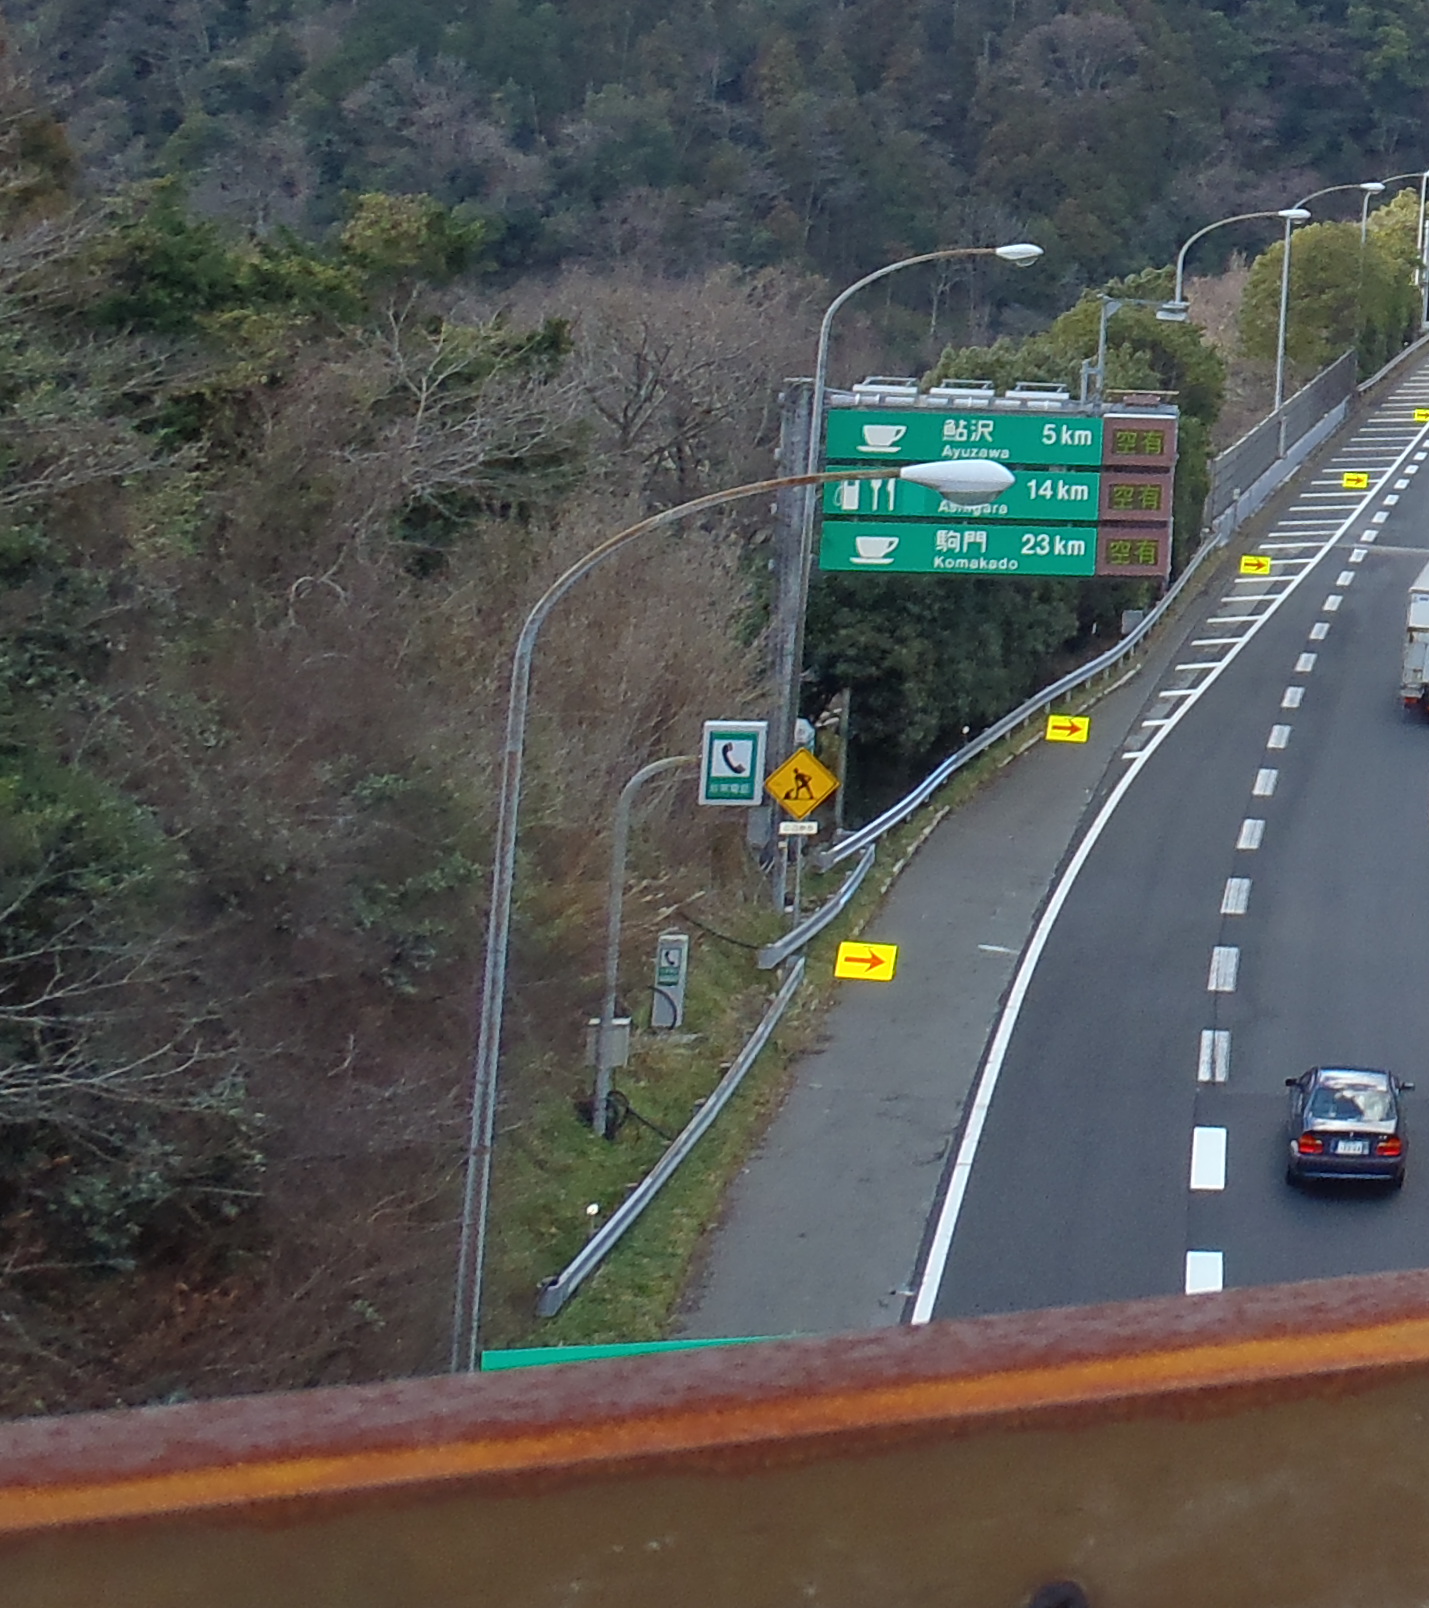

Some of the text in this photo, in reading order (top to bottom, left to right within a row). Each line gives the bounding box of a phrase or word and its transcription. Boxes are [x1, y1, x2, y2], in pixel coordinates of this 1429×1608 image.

[942, 419, 1093, 446] 鮎沢 5 km
[1115, 431, 1162, 454] 空有
[942, 444, 1010, 459] Ayuzawa
[1027, 478, 1089, 501] 14 km
[1112, 484, 1159, 509] 空有
[935, 529, 1085, 556] 駒門 23 km
[1108, 540, 1156, 565] 空有
[933, 555, 1019, 570] Komakado
